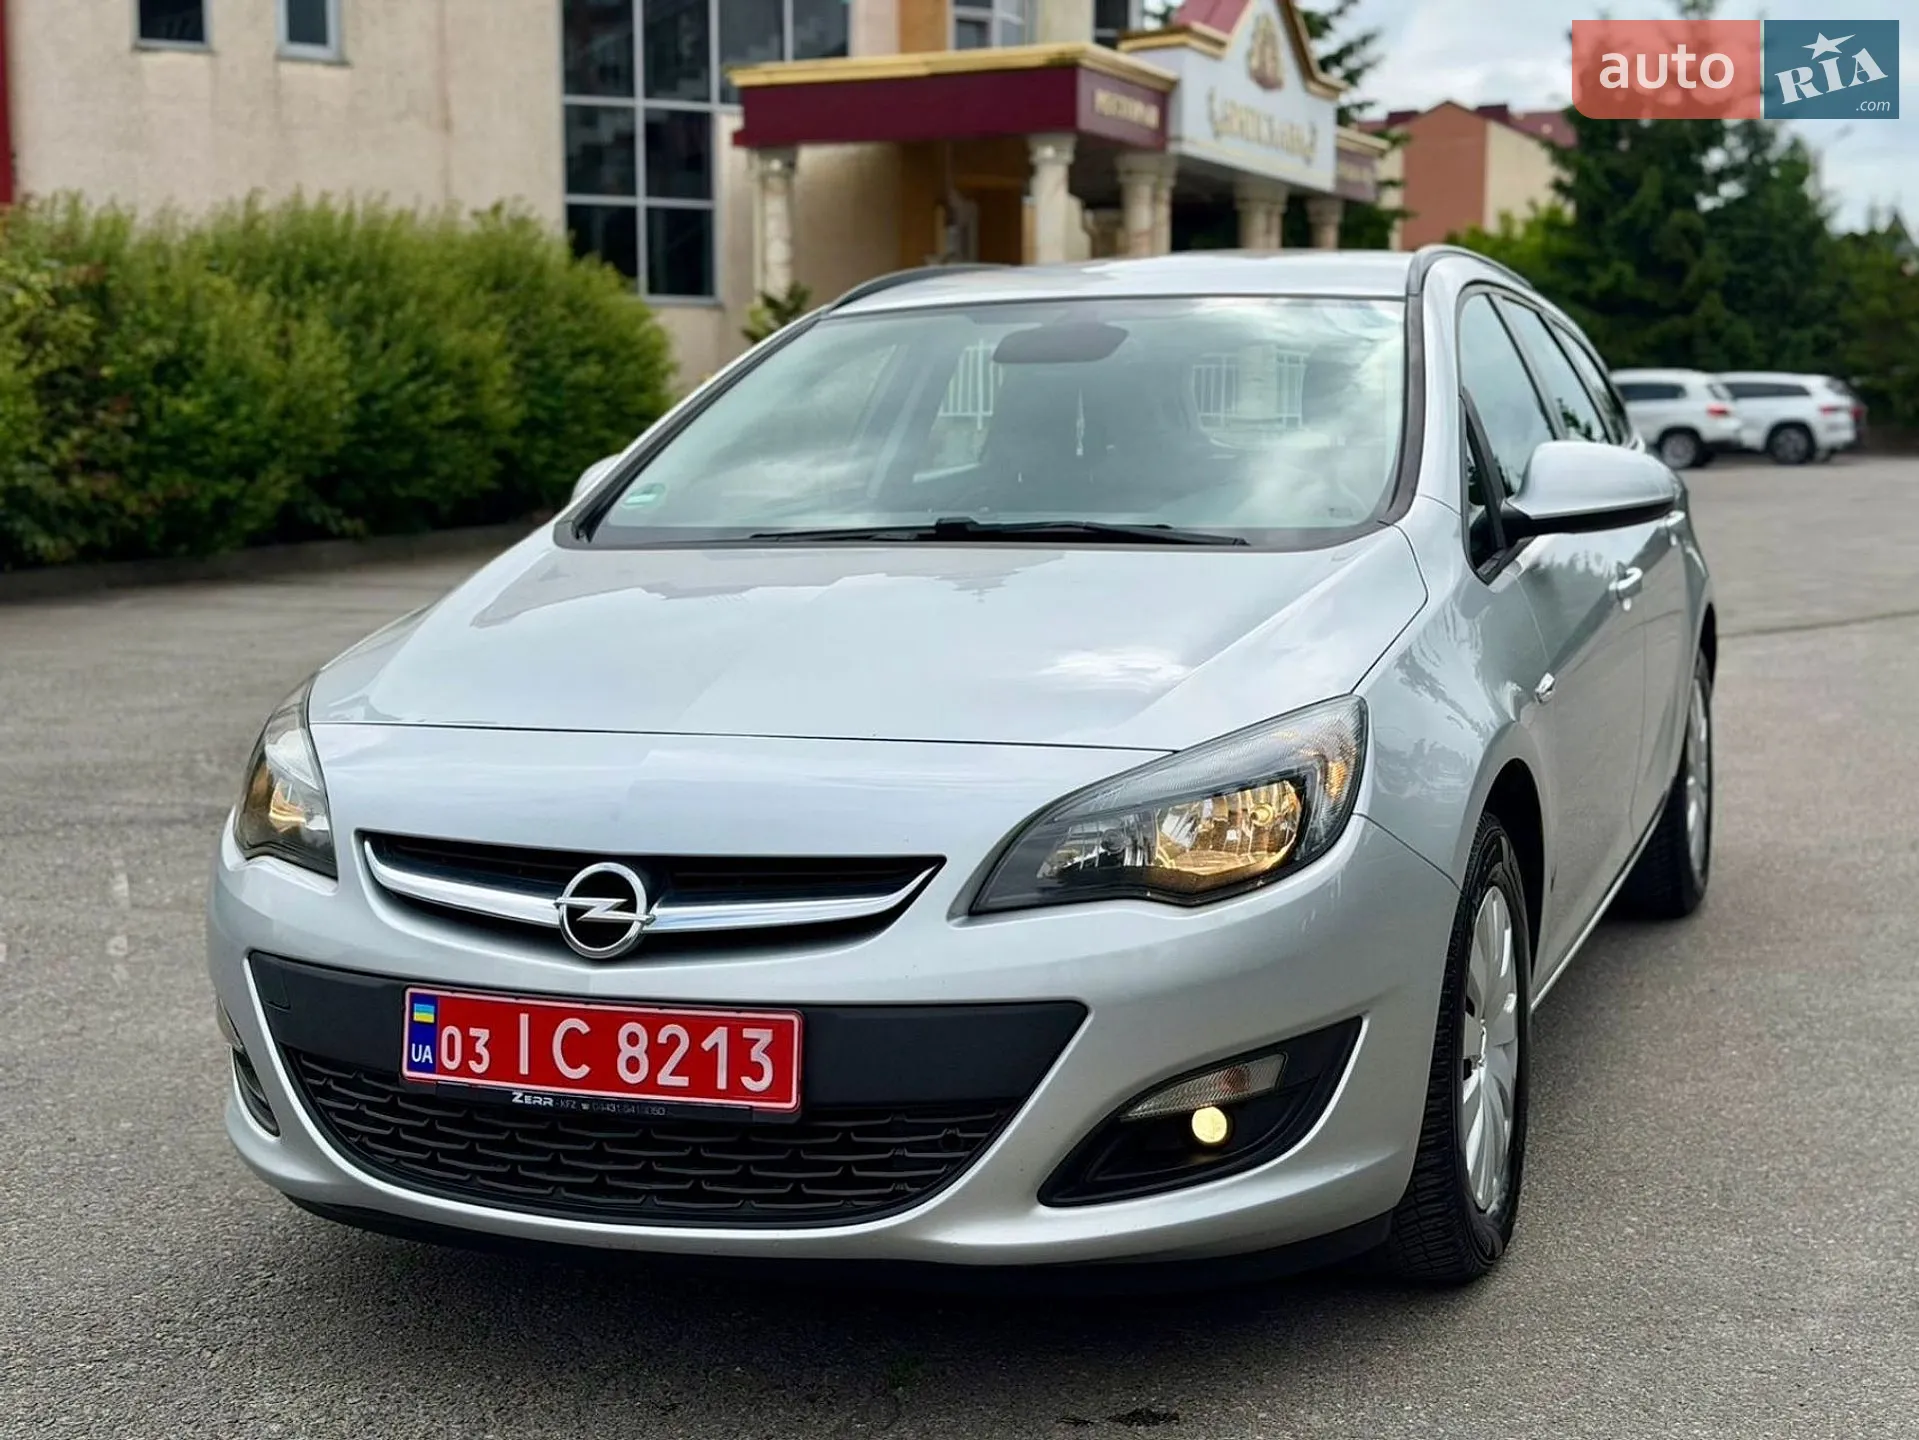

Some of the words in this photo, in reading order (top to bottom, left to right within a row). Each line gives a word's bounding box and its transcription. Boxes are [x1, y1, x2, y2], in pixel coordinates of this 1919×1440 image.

[411, 1043, 433, 1064] UA
[440, 1025, 491, 1074] 03
[616, 1021, 774, 1092] 8213
[511, 1092, 554, 1107] ZERR
